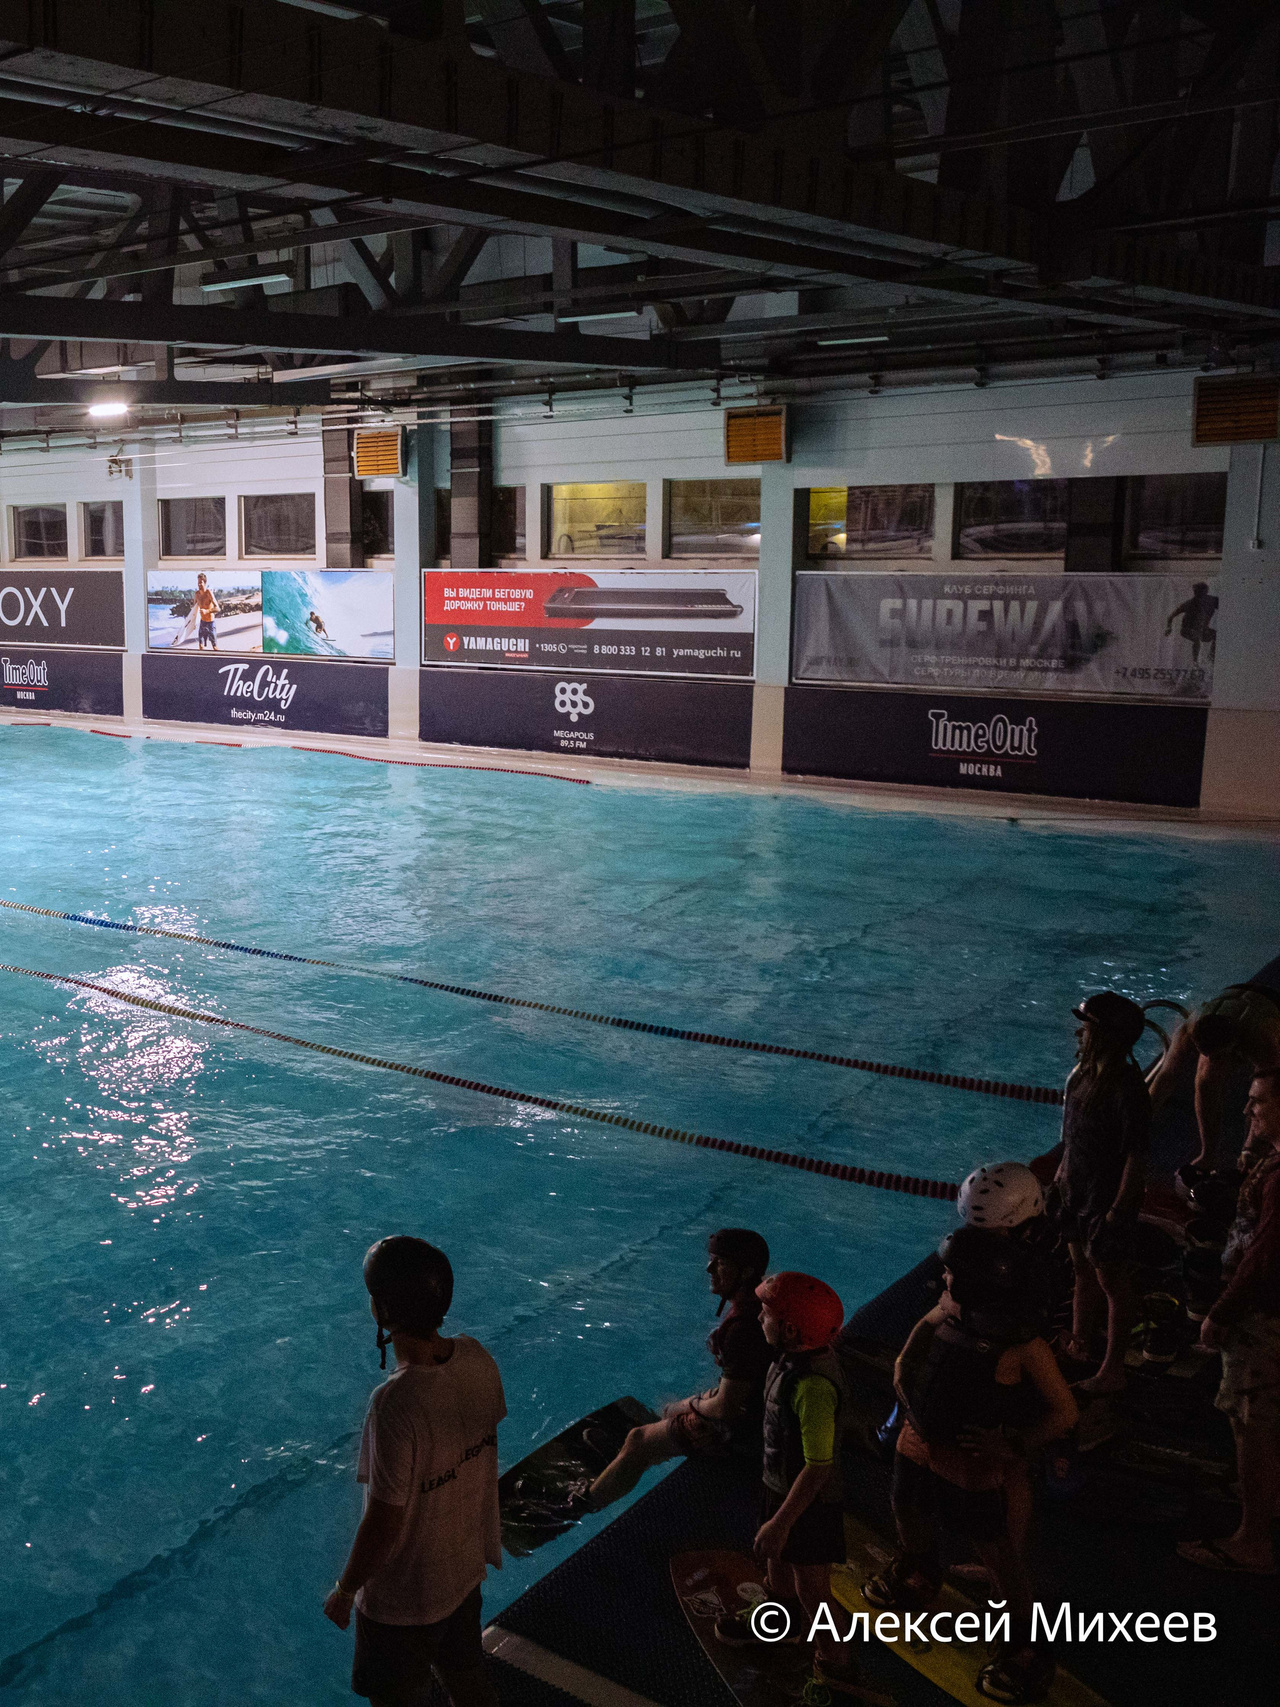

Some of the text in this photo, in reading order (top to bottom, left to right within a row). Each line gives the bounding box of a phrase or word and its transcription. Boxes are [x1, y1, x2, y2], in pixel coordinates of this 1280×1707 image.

[443, 588, 534, 599] ВЫ ВИДЕЛИ БЕГОВУЮ
[943, 585, 1036, 595] КЛУБ СЕРФИНГА
[443, 600, 525, 612] ДОРОЖКУ ТОНЬШЕ?
[463, 636, 529, 652] YAMAGUCHI
[593, 646, 600, 655] 8
[601, 646, 618, 655] 800
[619, 646, 636, 656] 333
[641, 647, 650, 656] 12
[656, 647, 666, 656] 81
[1009, 658, 1017, 666] В
[230, 707, 286, 722] thecity.m24.ru
[553, 730, 595, 740] MEGAPOLIS
[959, 762, 1002, 777] МОСКВА
